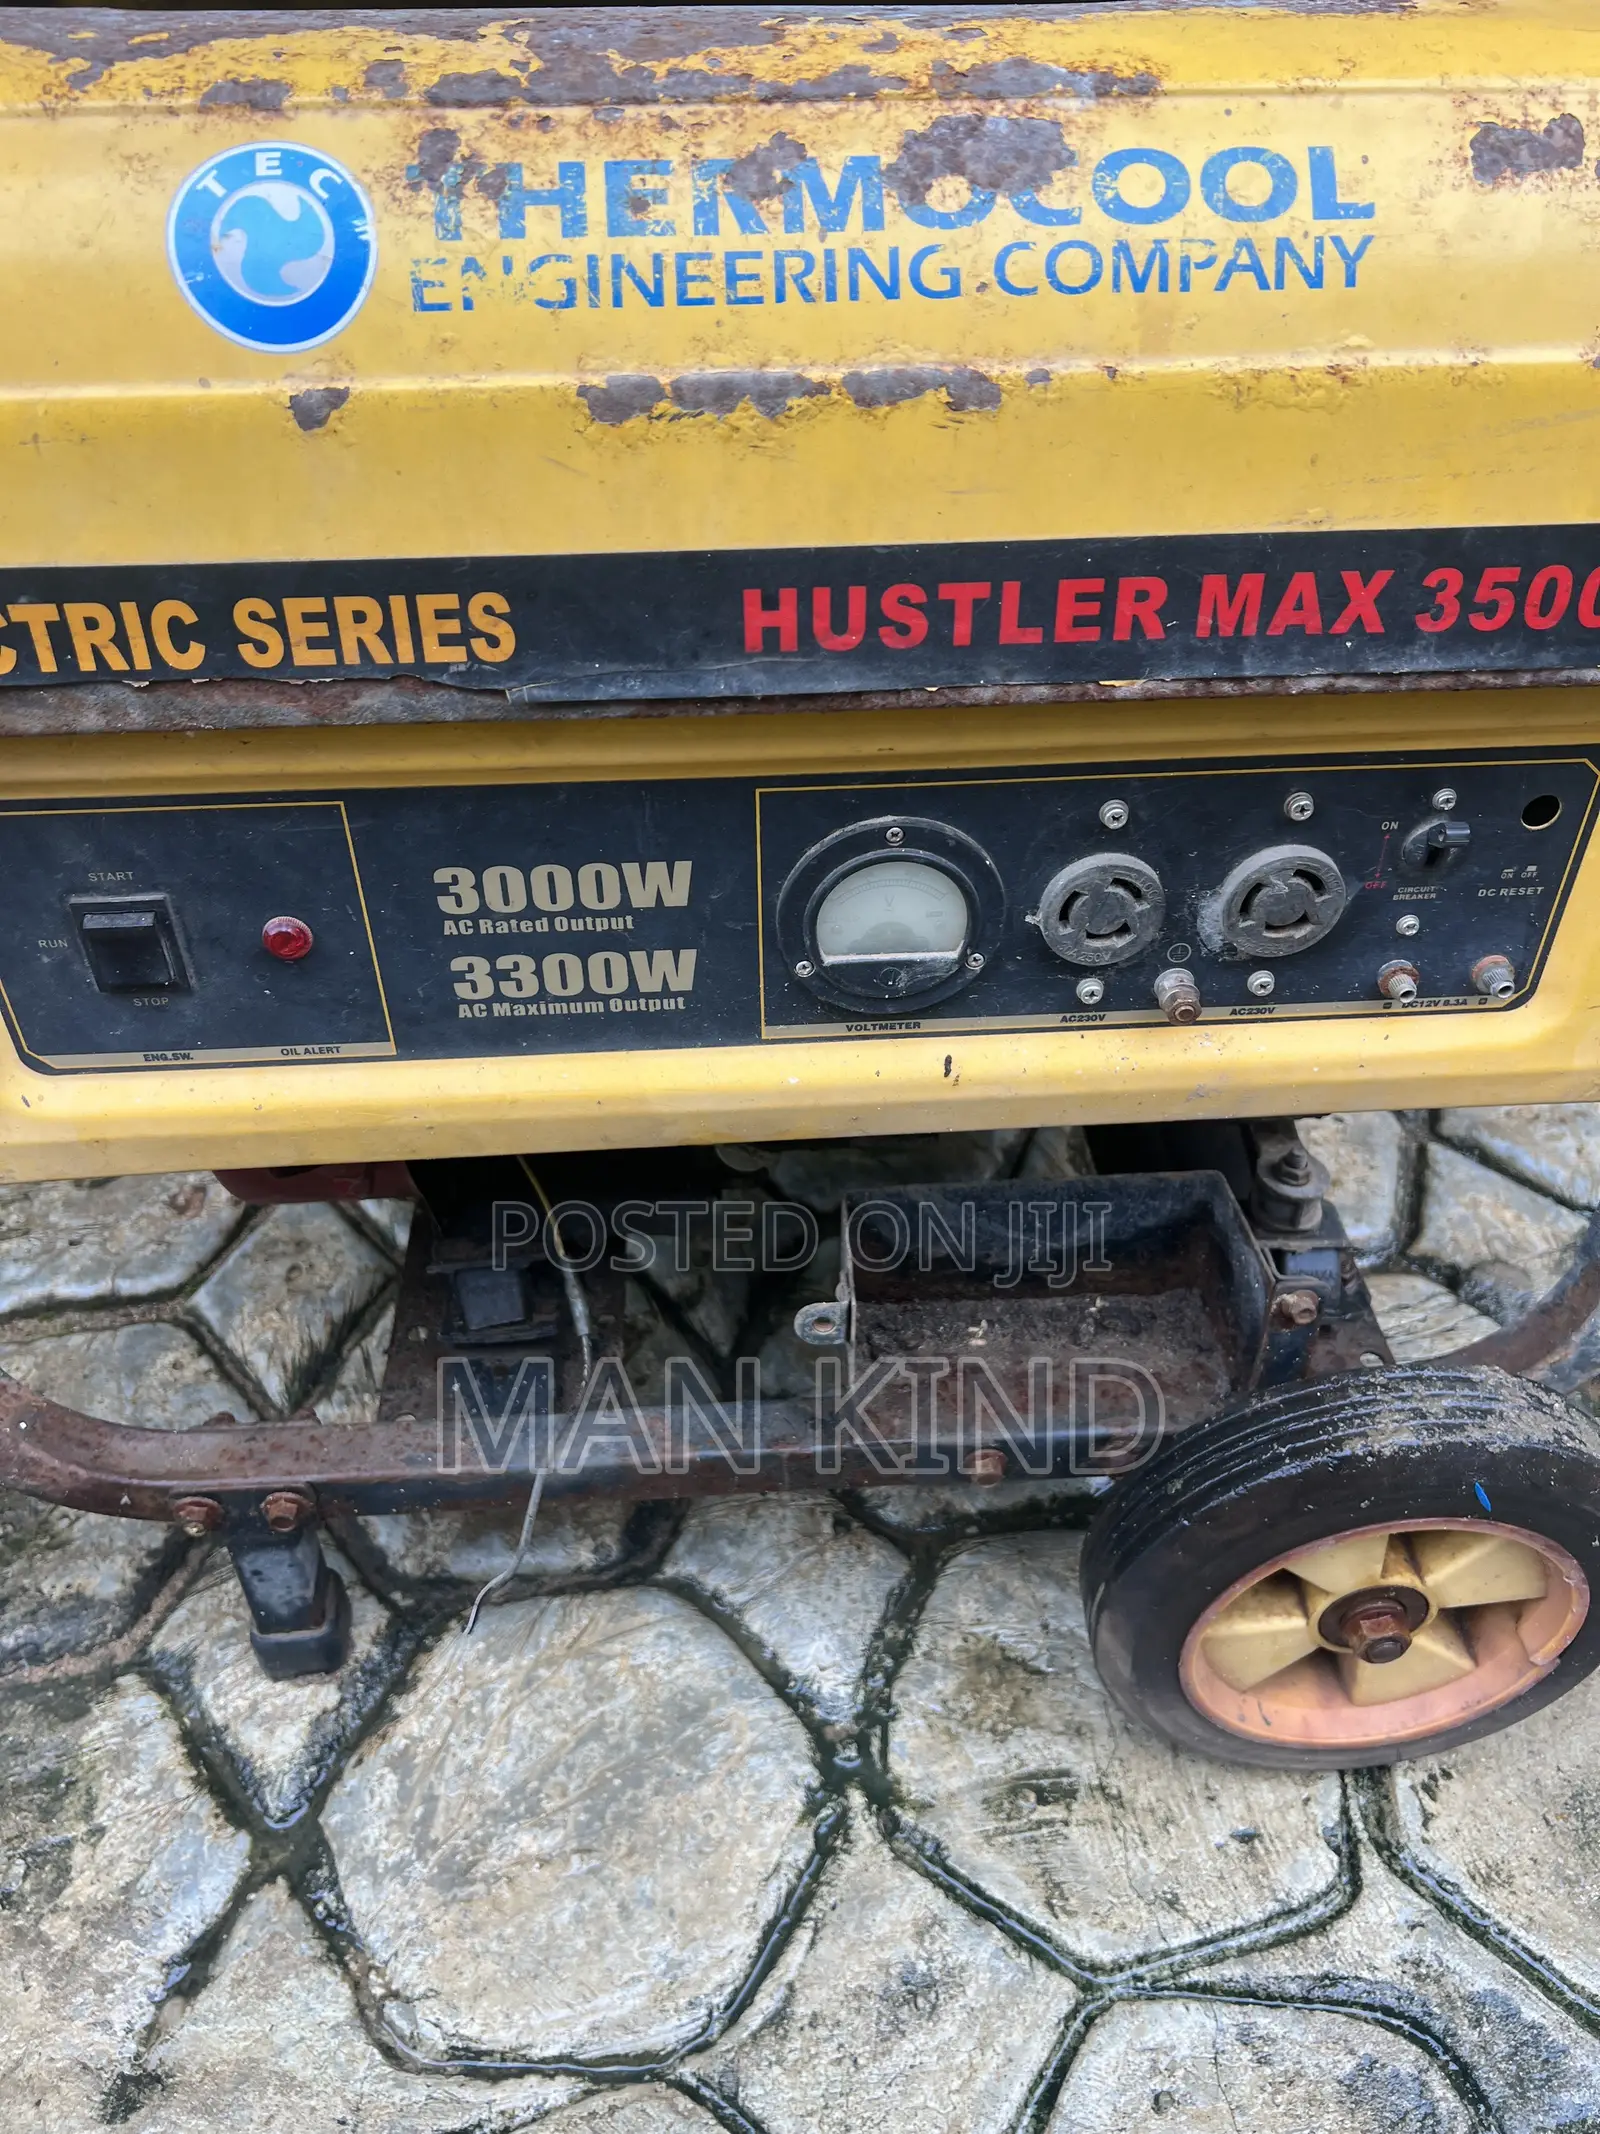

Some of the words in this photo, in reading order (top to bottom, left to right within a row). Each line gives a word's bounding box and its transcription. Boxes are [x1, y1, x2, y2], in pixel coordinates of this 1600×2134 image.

[195, 152, 344, 199] TEC
[993, 234, 1375, 298] COMPANY
[742, 575, 1169, 653] HUSTLER
[1195, 569, 1396, 638] MAX
[233, 592, 516, 667] SERIES
[1381, 821, 1399, 831] ON
[88, 871, 134, 882] START
[1500, 871, 1514, 880] ON
[1520, 871, 1538, 879] OFF
[432, 860, 693, 915] 3000W
[1364, 880, 1388, 890] OFF
[1397, 886, 1436, 894] CIRCUIT
[1392, 892, 1437, 901] BREAKER
[1477, 888, 1497, 897] DC
[1499, 886, 1545, 897] RESET
[443, 919, 474, 936] AC
[480, 916, 549, 935] Rated
[554, 914, 635, 932] Output
[38, 938, 68, 950] RUN
[1079, 951, 1112, 962] 250V
[450, 948, 698, 1000] 3300W
[133, 996, 170, 1008] STOP
[458, 1003, 488, 1018] AC
[492, 1000, 604, 1017] Maximum
[609, 996, 686, 1014] Output
[1229, 1006, 1276, 1017] AC230V
[1060, 1013, 1106, 1024] AC230V
[846, 1021, 921, 1033] VOLTMETER
[280, 1047, 301, 1057] OIL
[303, 1045, 341, 1056] ALERT
[143, 1052, 194, 1063] ENG.SW.
